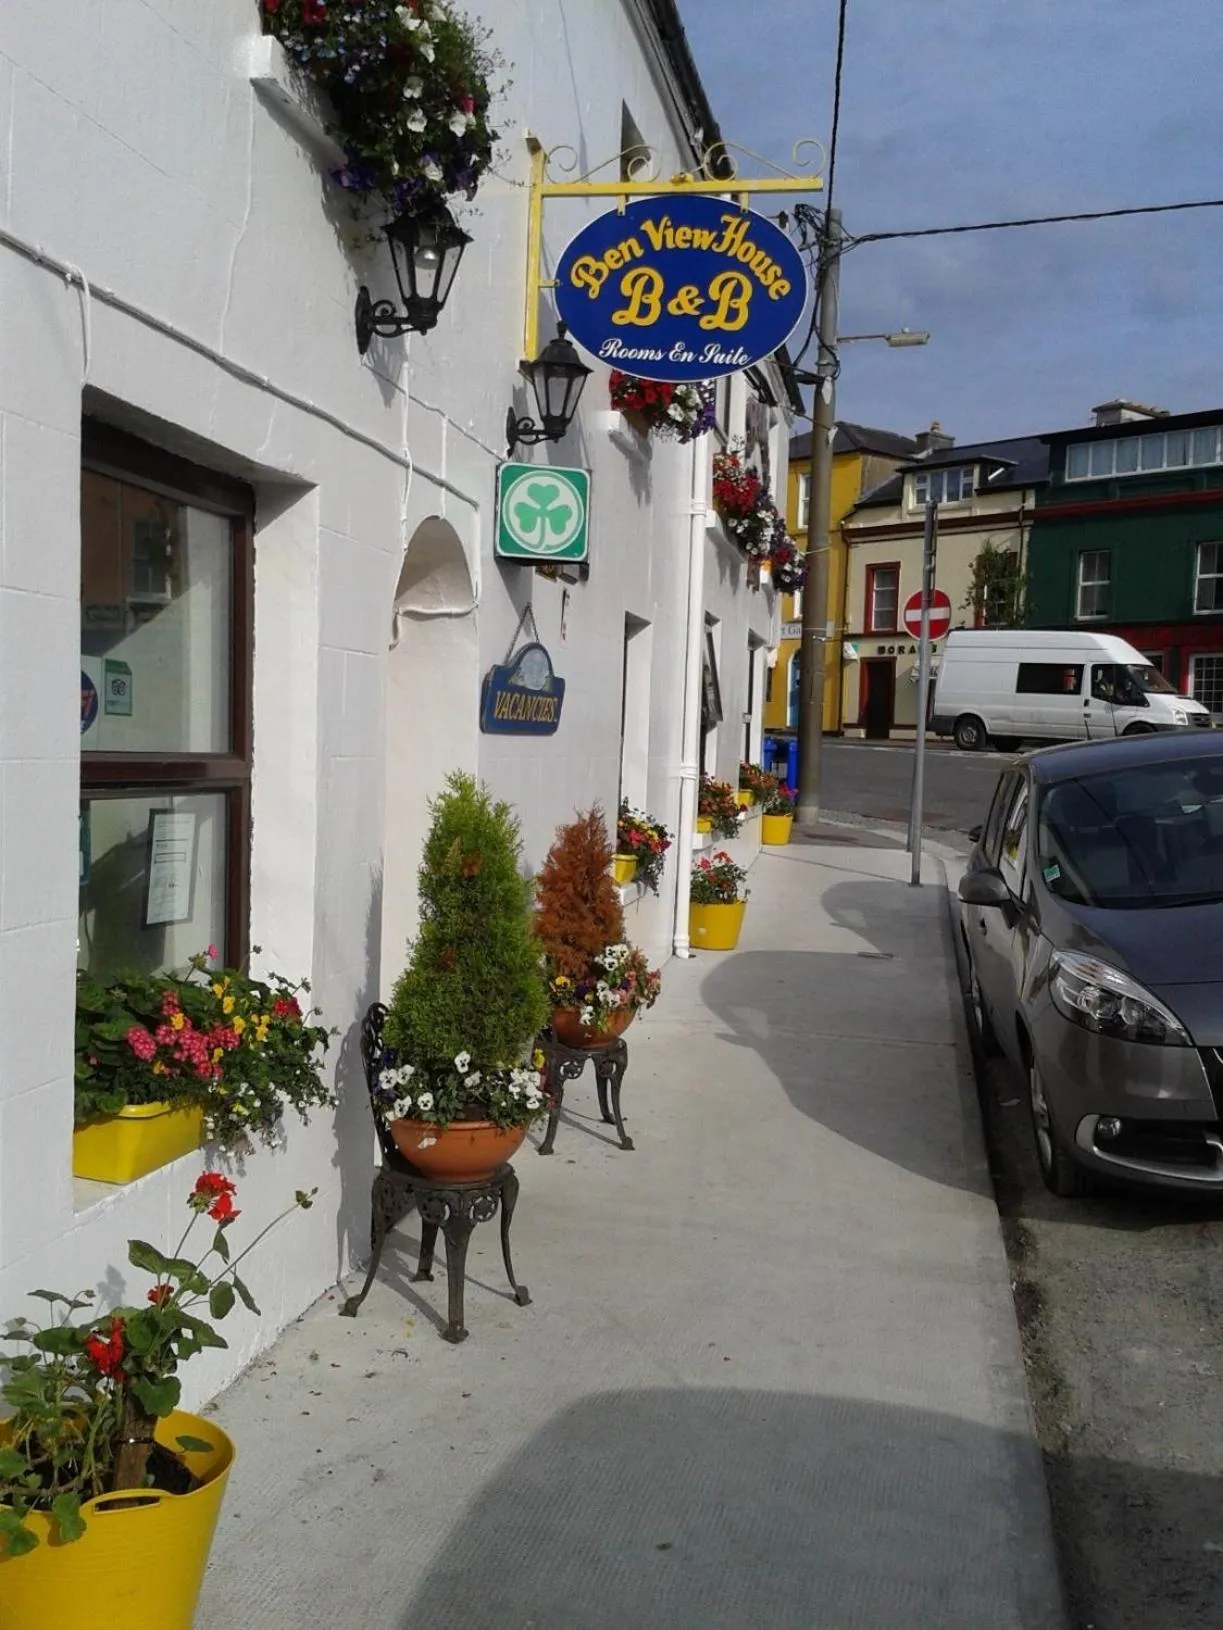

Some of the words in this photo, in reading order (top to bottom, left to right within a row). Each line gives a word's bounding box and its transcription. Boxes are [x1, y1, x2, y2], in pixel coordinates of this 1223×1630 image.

[570, 235, 645, 300] Ben
[640, 215, 717, 252] View
[712, 214, 792, 300] House
[599, 338, 666, 361] Rooms
[668, 341, 697, 363] En
[699, 342, 751, 366] Suite
